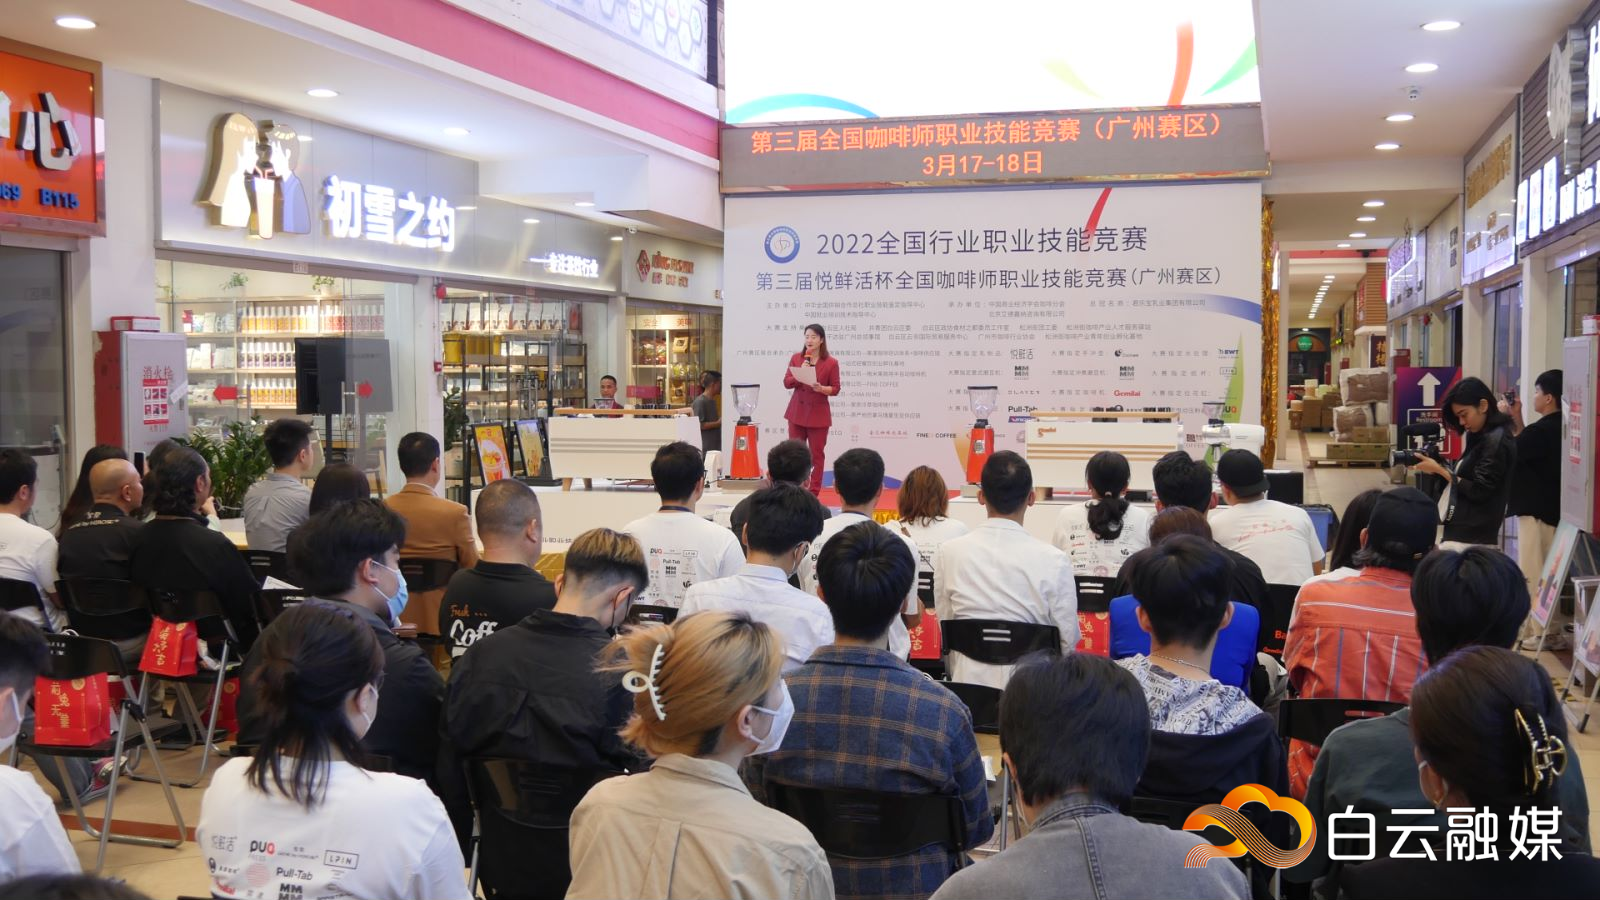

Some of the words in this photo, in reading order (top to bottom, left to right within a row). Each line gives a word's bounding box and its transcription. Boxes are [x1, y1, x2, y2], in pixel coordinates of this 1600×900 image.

[751, 113, 1221, 154] 第三届全国咖啡师职业技能竞赛（广州赛区）
[922, 151, 1042, 177] 3月17-18日
[39, 188, 80, 209] B115
[325, 174, 456, 252] 初雪之约
[816, 226, 1148, 256] 2022全国行业职业技能竞赛
[276, 867, 313, 881] Pull-Tab
